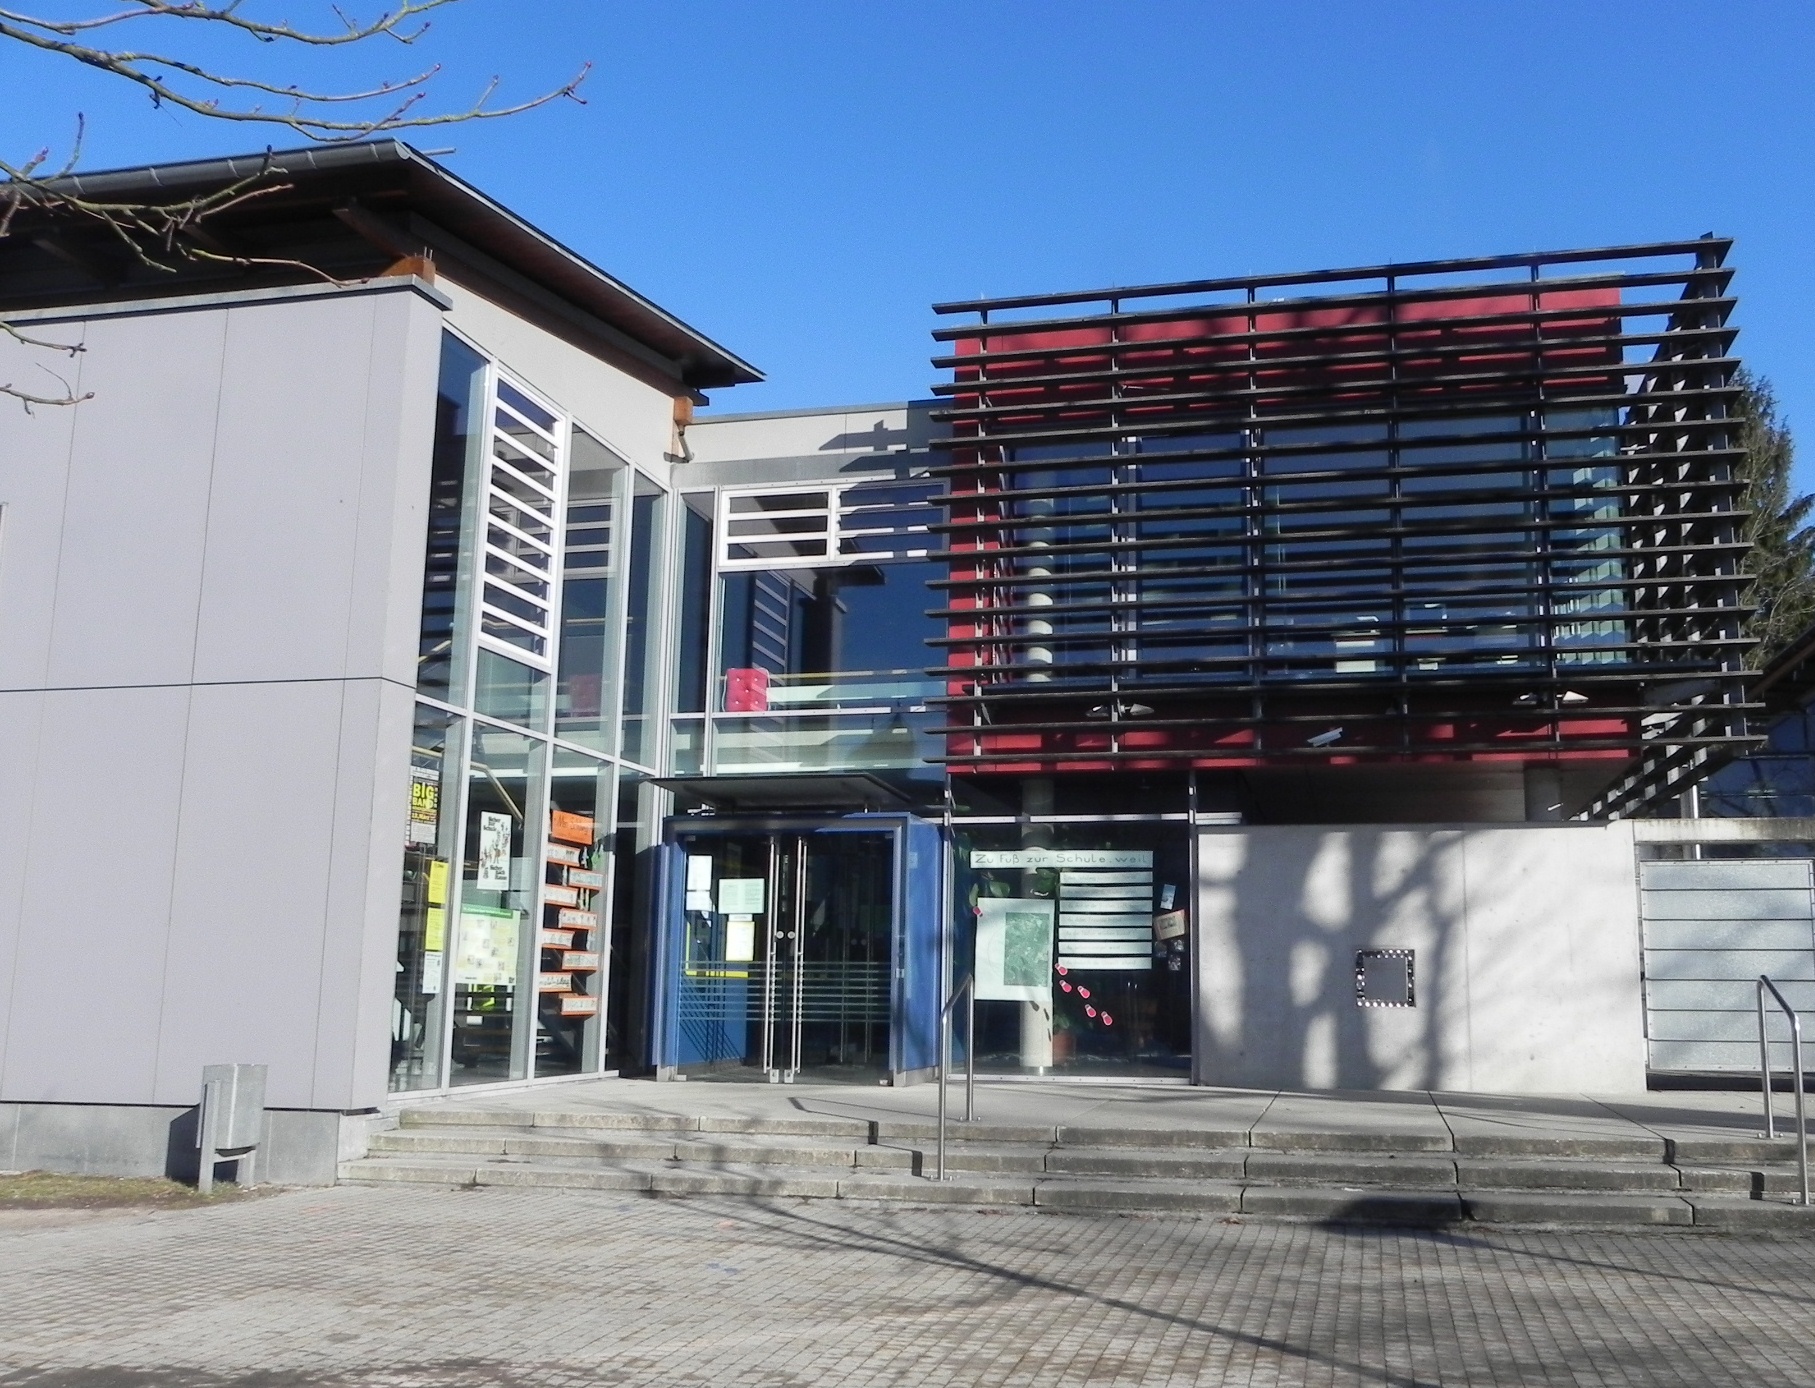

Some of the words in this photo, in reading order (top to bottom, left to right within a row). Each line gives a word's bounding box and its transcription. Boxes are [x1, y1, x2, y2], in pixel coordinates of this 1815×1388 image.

[413, 782, 435, 799] BIG
[975, 854, 994, 864] Zu
[1000, 854, 1020, 864] Fuß
[1115, 855, 1147, 863] weil
